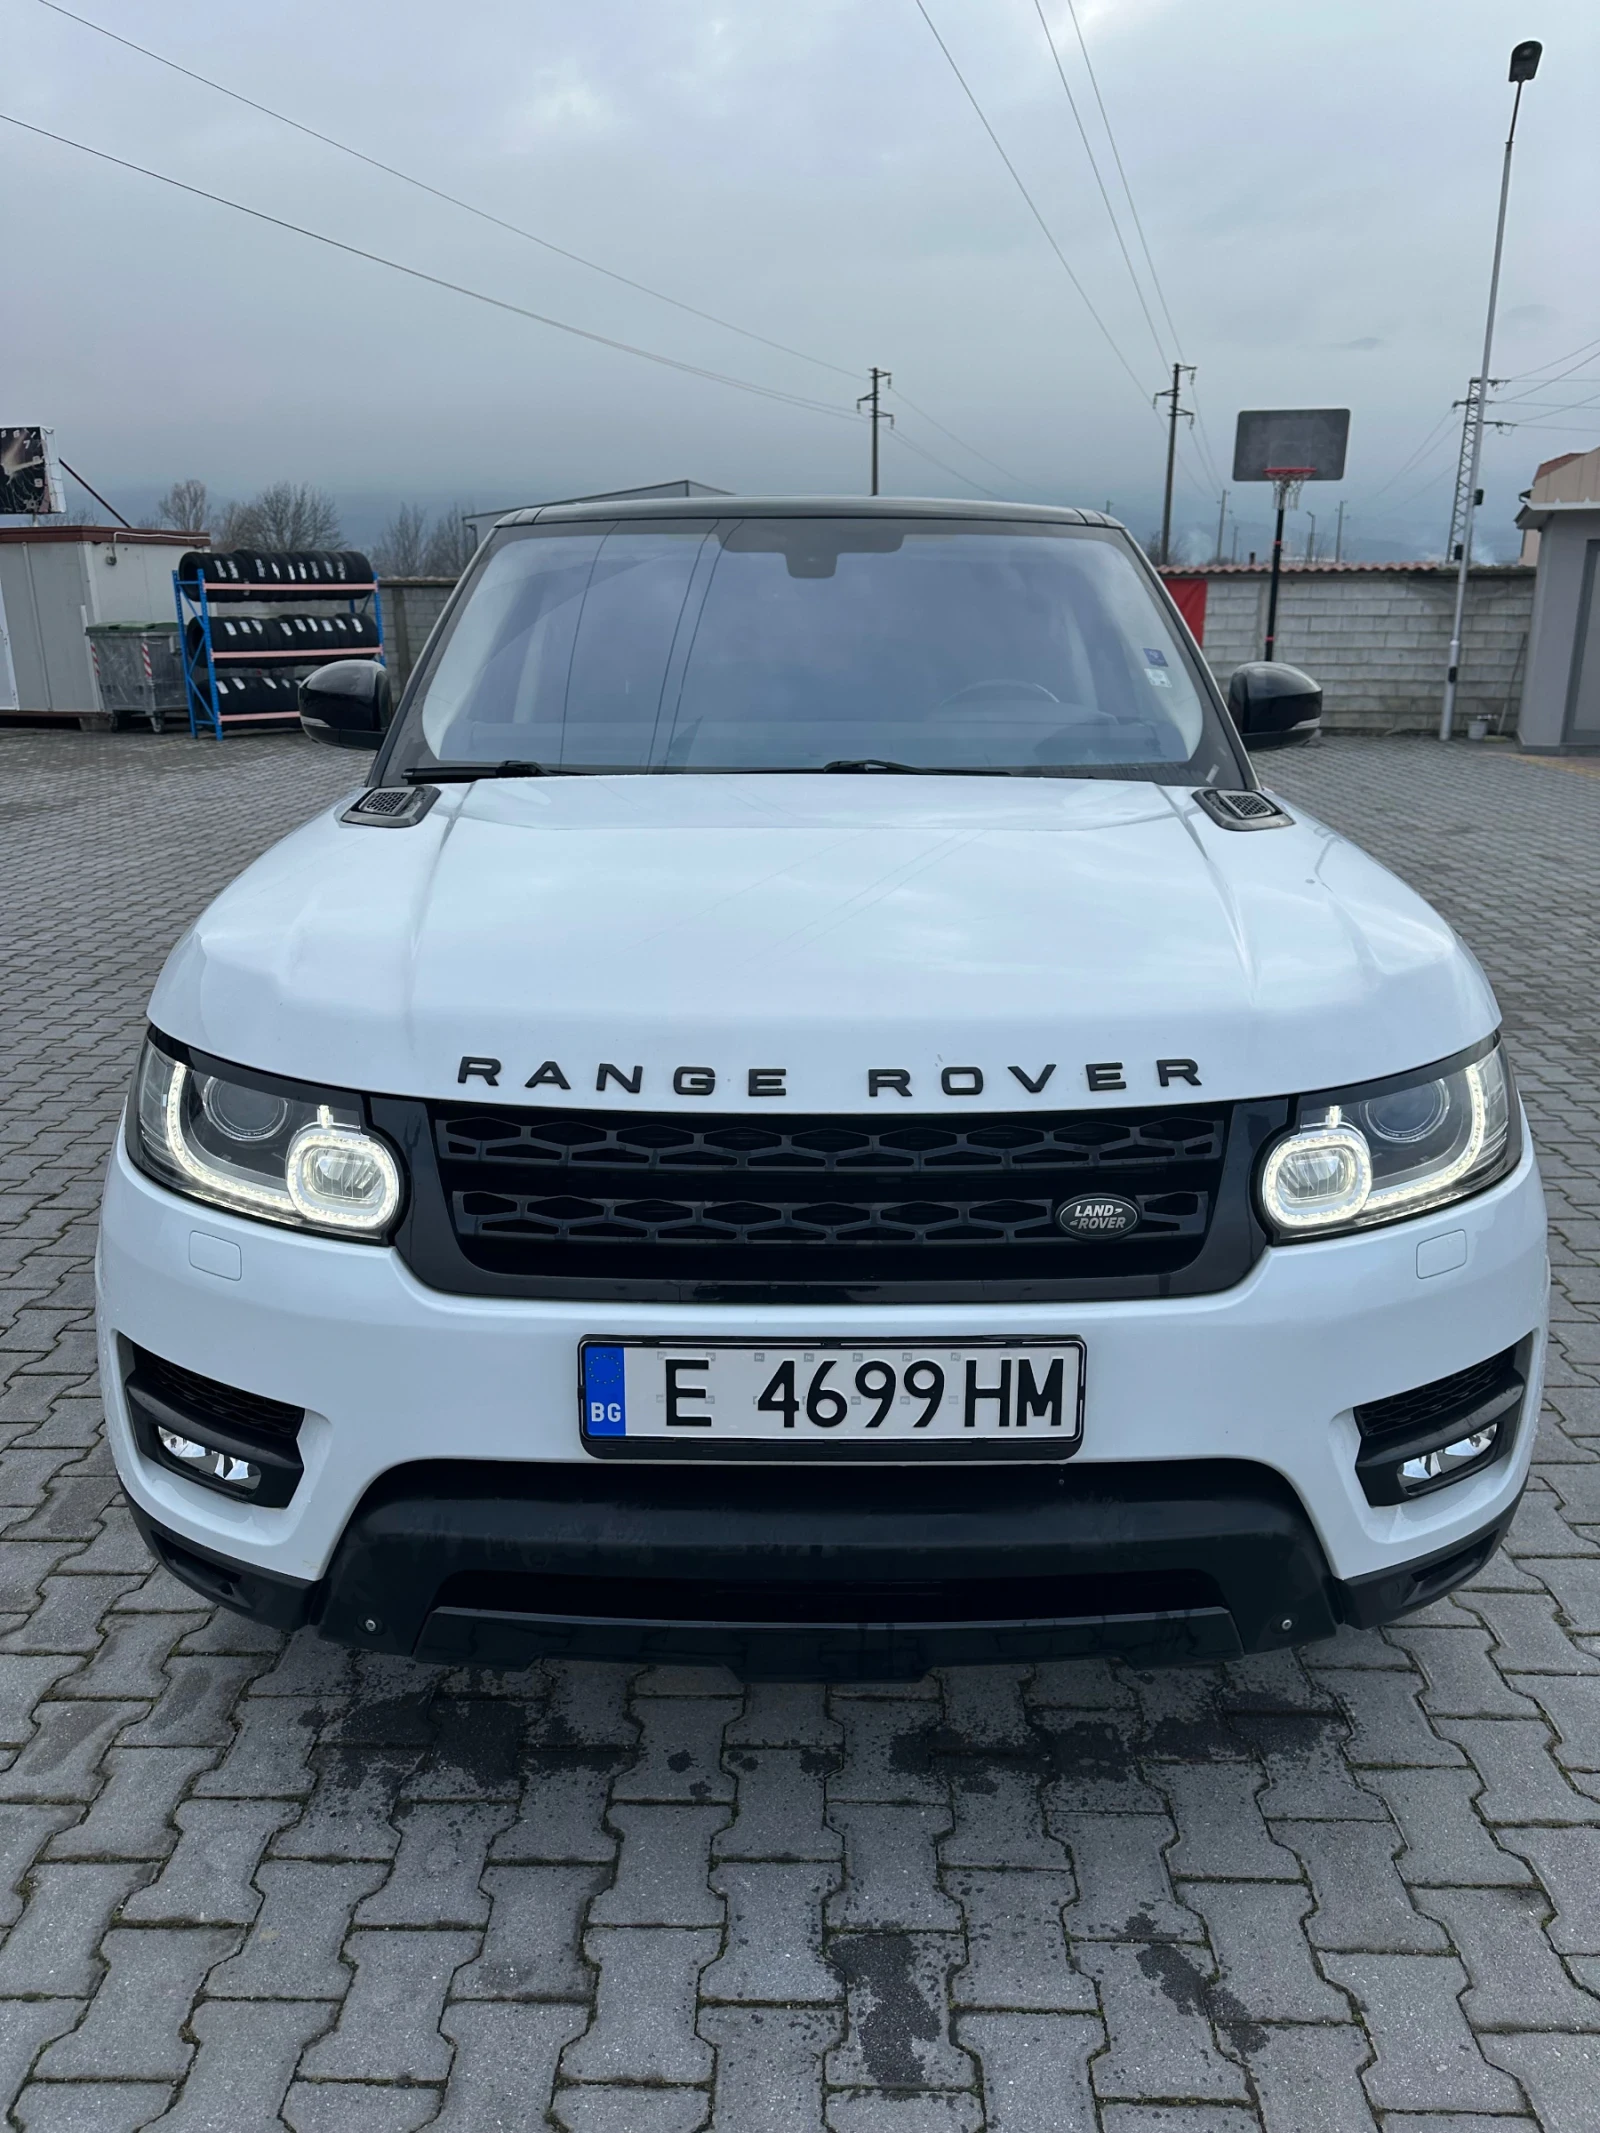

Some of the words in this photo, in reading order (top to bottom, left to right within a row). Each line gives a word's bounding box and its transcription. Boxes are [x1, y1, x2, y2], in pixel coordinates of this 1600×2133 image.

[457, 1056, 787, 1097] RANGE
[868, 1058, 1203, 1098] ROVER
[1074, 1204, 1115, 1217] LAND
[1078, 1216, 1127, 1230] ROVER
[665, 1358, 713, 1427] E
[757, 1359, 945, 1429] 4699
[964, 1357, 1065, 1428] HM
[590, 1402, 622, 1423] BG
